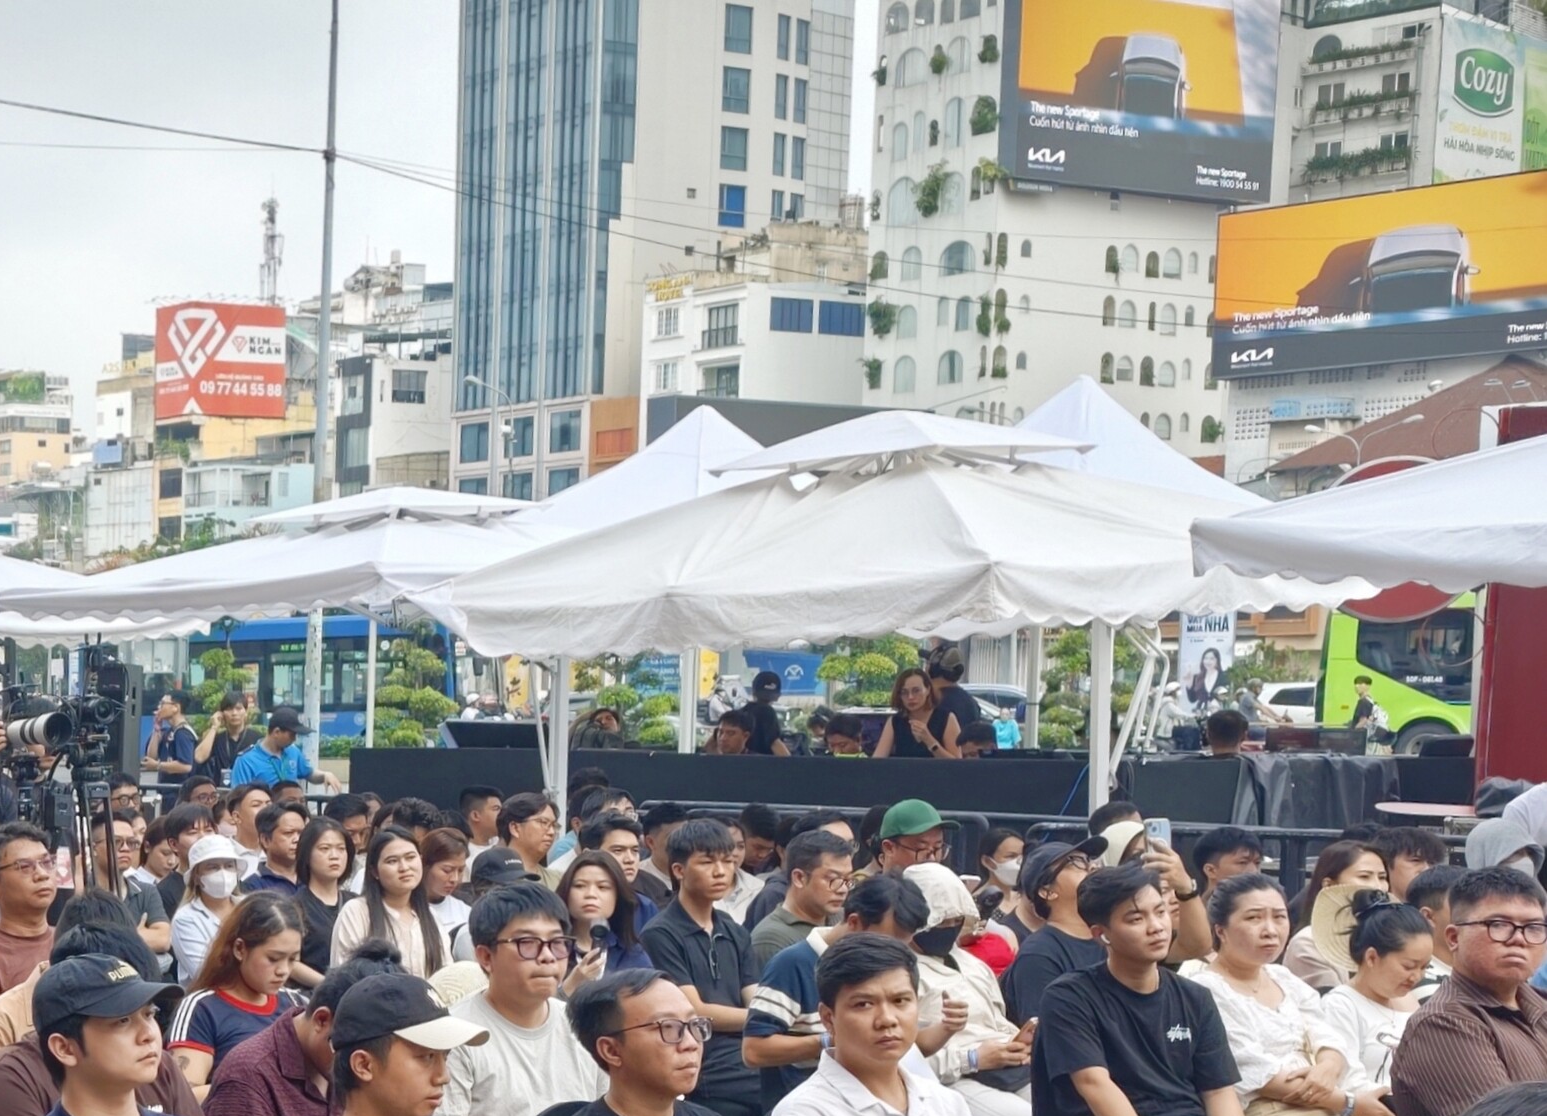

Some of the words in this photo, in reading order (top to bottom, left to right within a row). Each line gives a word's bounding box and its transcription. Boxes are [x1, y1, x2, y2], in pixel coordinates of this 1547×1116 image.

[1460, 56, 1508, 105] Cozy
[1030, 100, 1047, 113] The
[1047, 104, 1064, 115] new
[1064, 104, 1100, 121] Sportage
[1027, 147, 1066, 164] KIA
[1233, 312, 1252, 323] The
[1252, 310, 1272, 320] new
[1274, 305, 1319, 318] Sportage
[1507, 323, 1525, 333] The
[1525, 322, 1545, 331] new
[249, 336, 271, 346] KIM
[1507, 333, 1542, 344] Hotline:
[249, 346, 282, 355] NGAN
[1230, 347, 1274, 363] KIA
[199, 380, 215, 394] 09
[216, 381, 232, 395] 77
[232, 382, 248, 396] 44
[250, 383, 265, 396] 55
